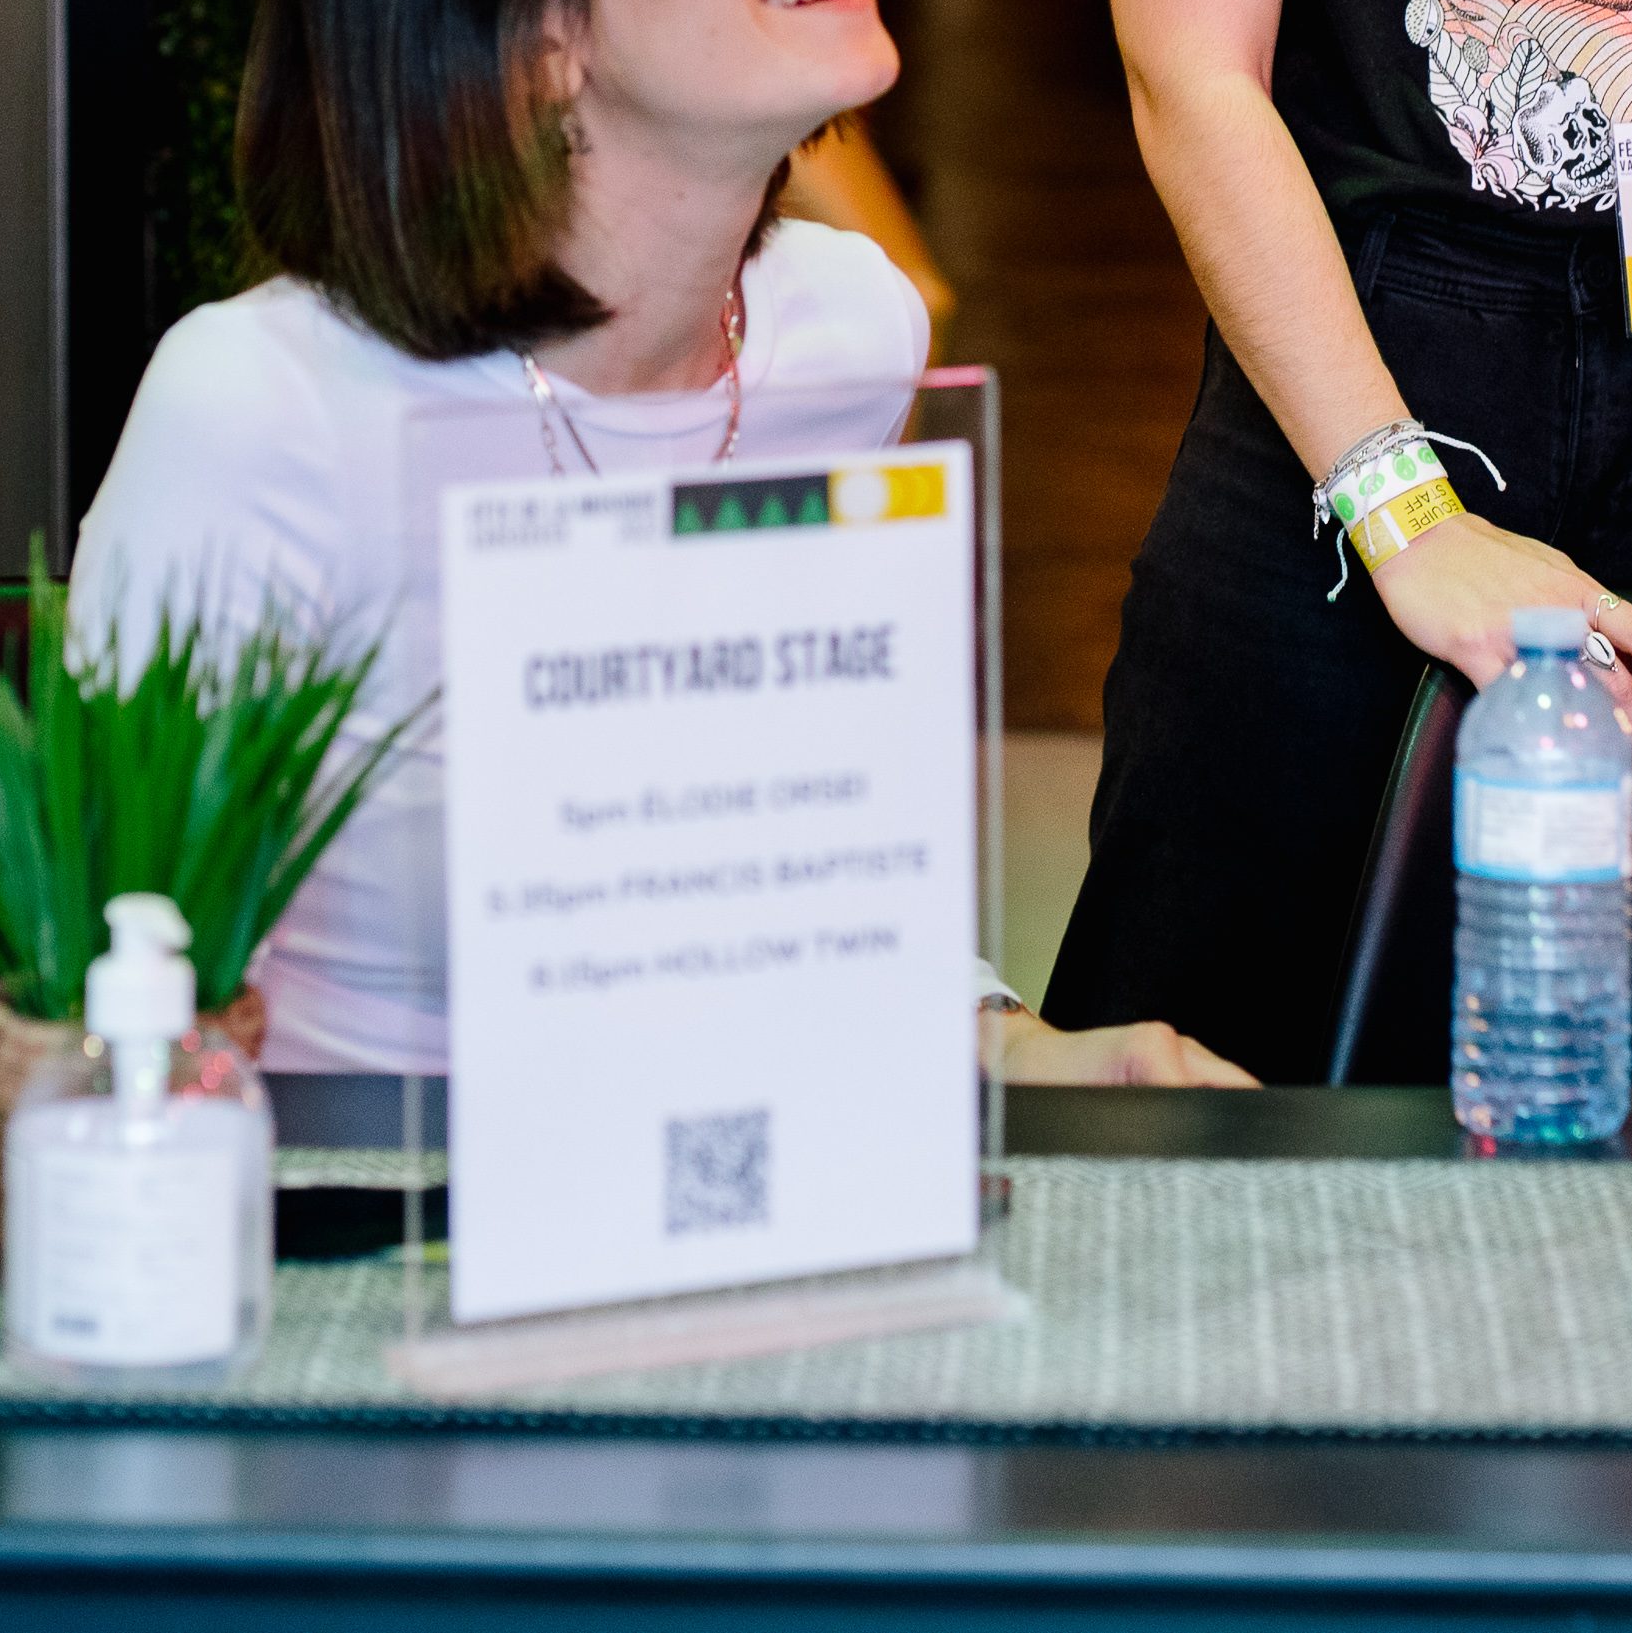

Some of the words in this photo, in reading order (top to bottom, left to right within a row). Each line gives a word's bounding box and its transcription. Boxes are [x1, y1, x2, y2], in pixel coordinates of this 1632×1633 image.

[1404, 484, 1447, 515] STAFF
[524, 635, 763, 711] COURTYARD
[774, 621, 899, 687] STAGE
[618, 862, 763, 907] FRANCIS
[774, 843, 931, 891] BAPTISTE
